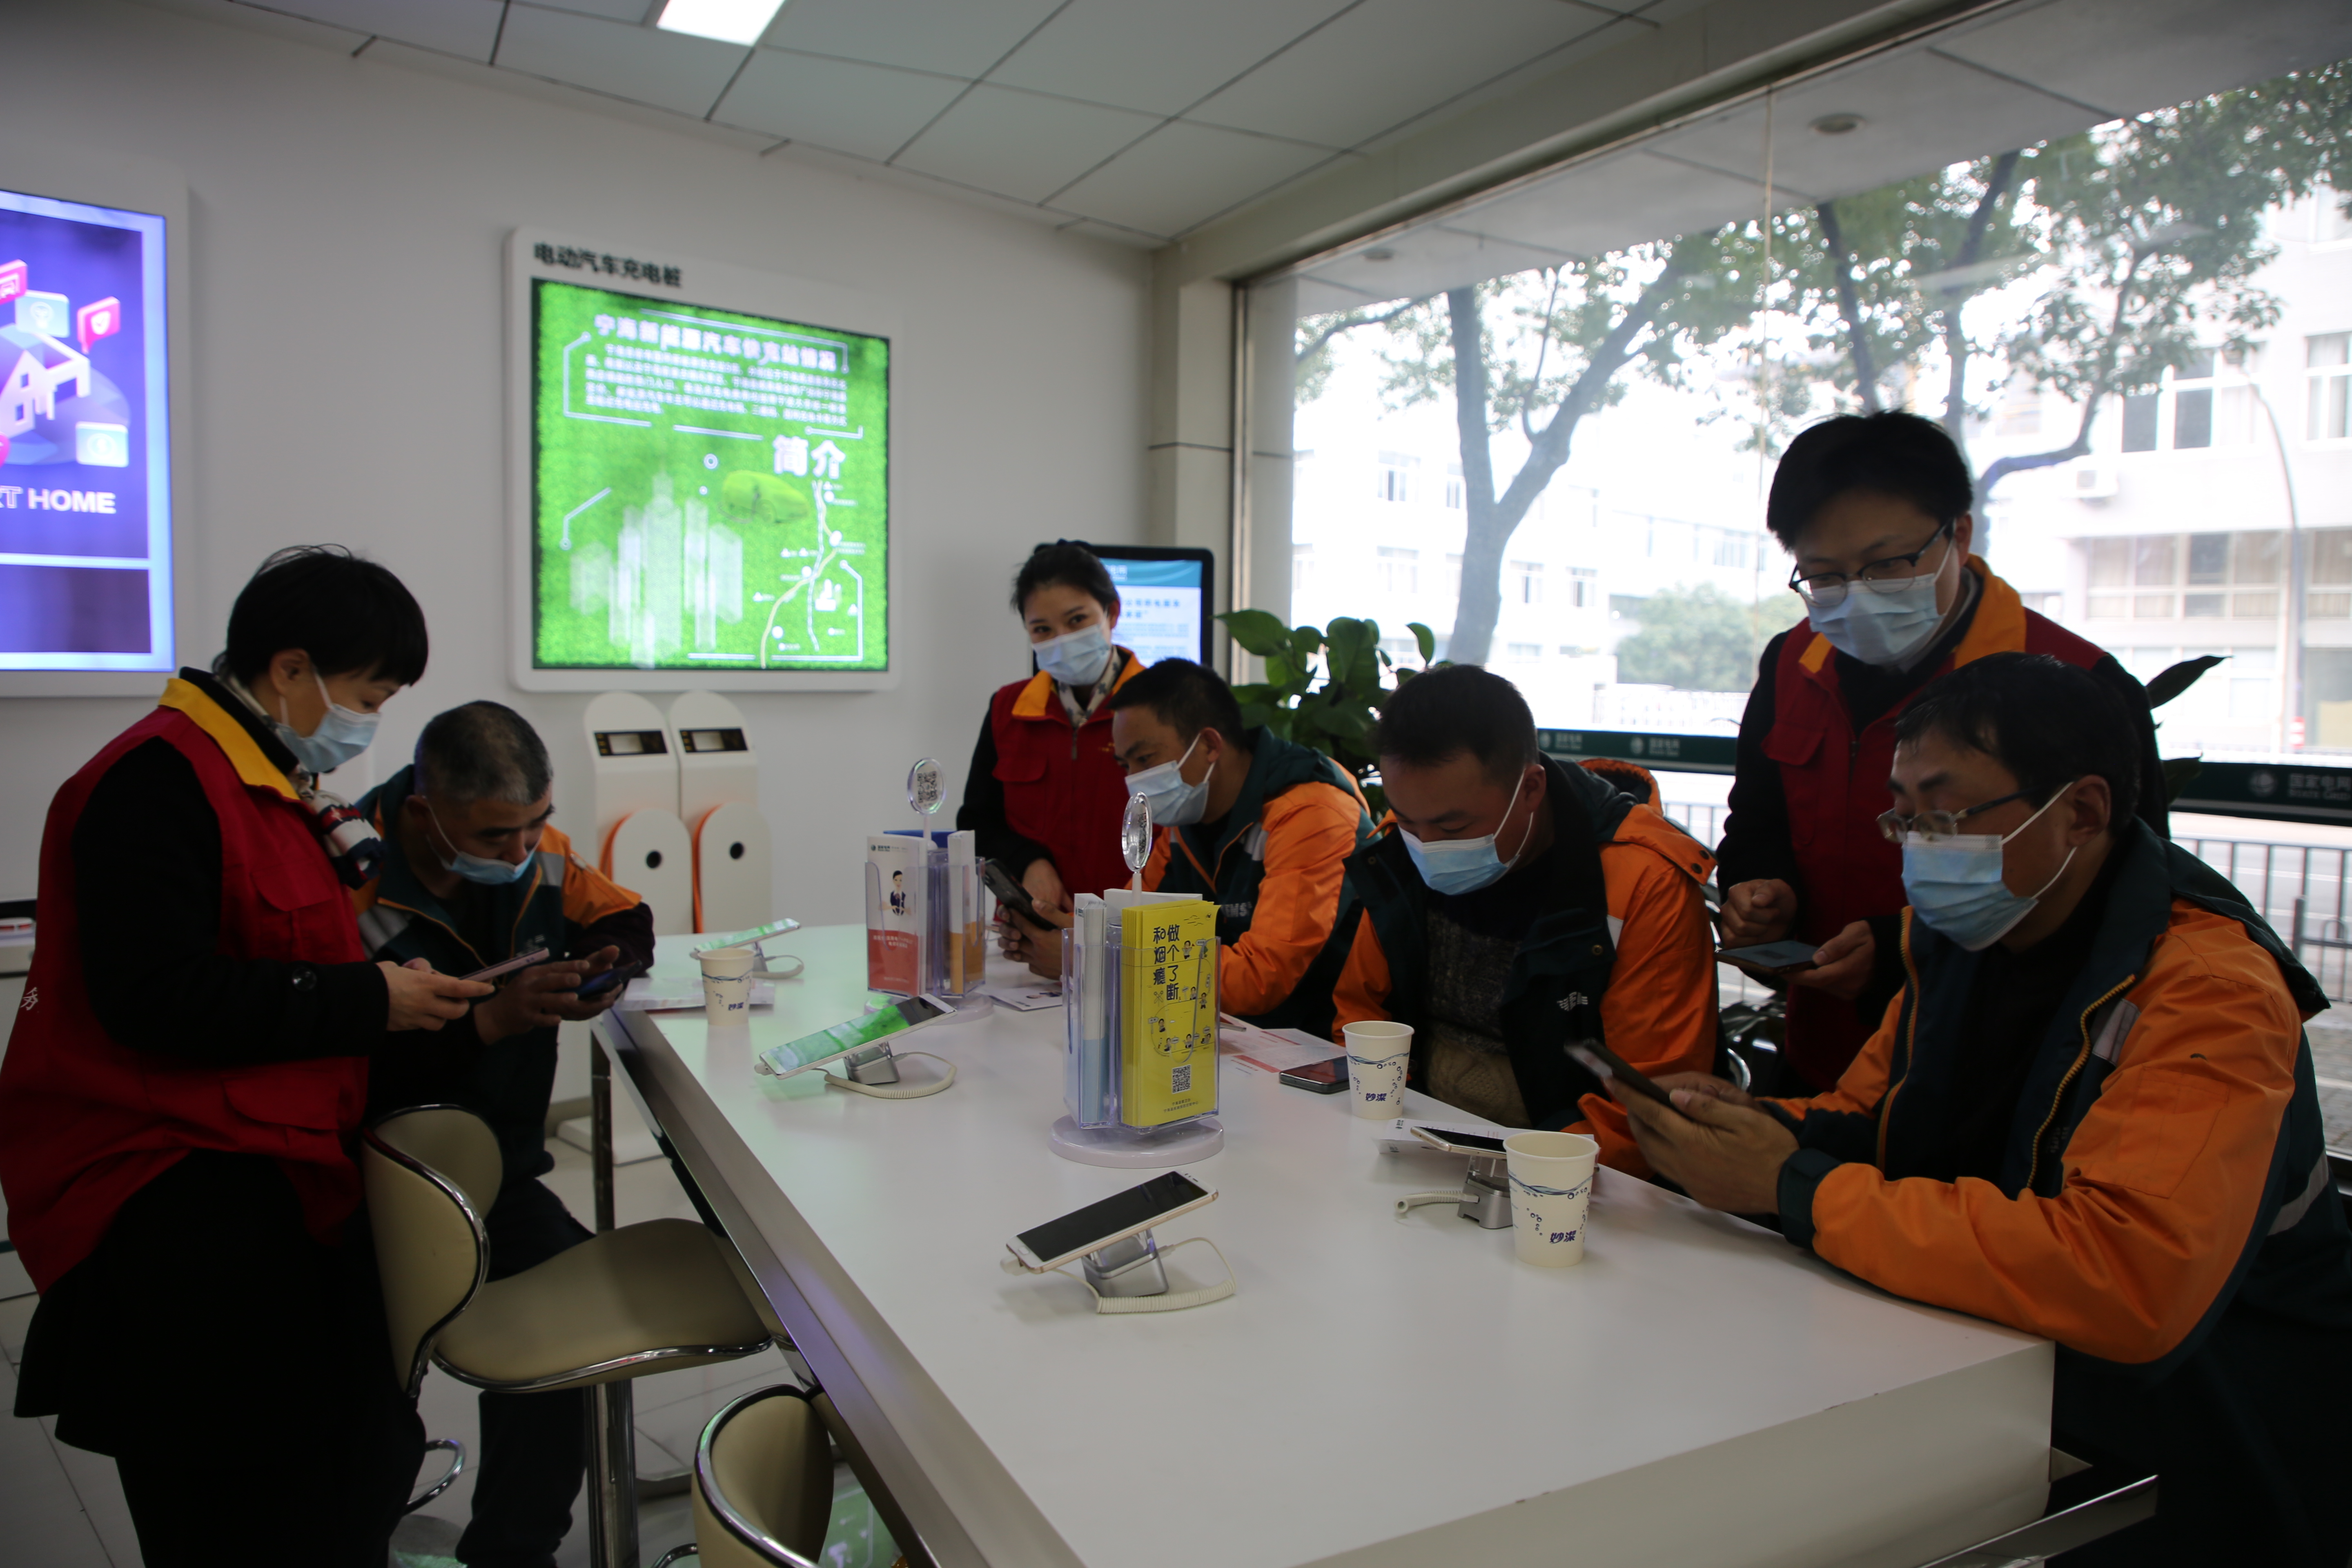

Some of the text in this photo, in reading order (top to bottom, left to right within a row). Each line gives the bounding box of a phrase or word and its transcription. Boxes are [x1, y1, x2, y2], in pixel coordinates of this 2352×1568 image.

[534, 241, 682, 288] 电动汽车充电桩
[772, 434, 846, 479] 简介
[28, 488, 117, 514] HOME
[1167, 924, 1180, 1001] 做个了断
